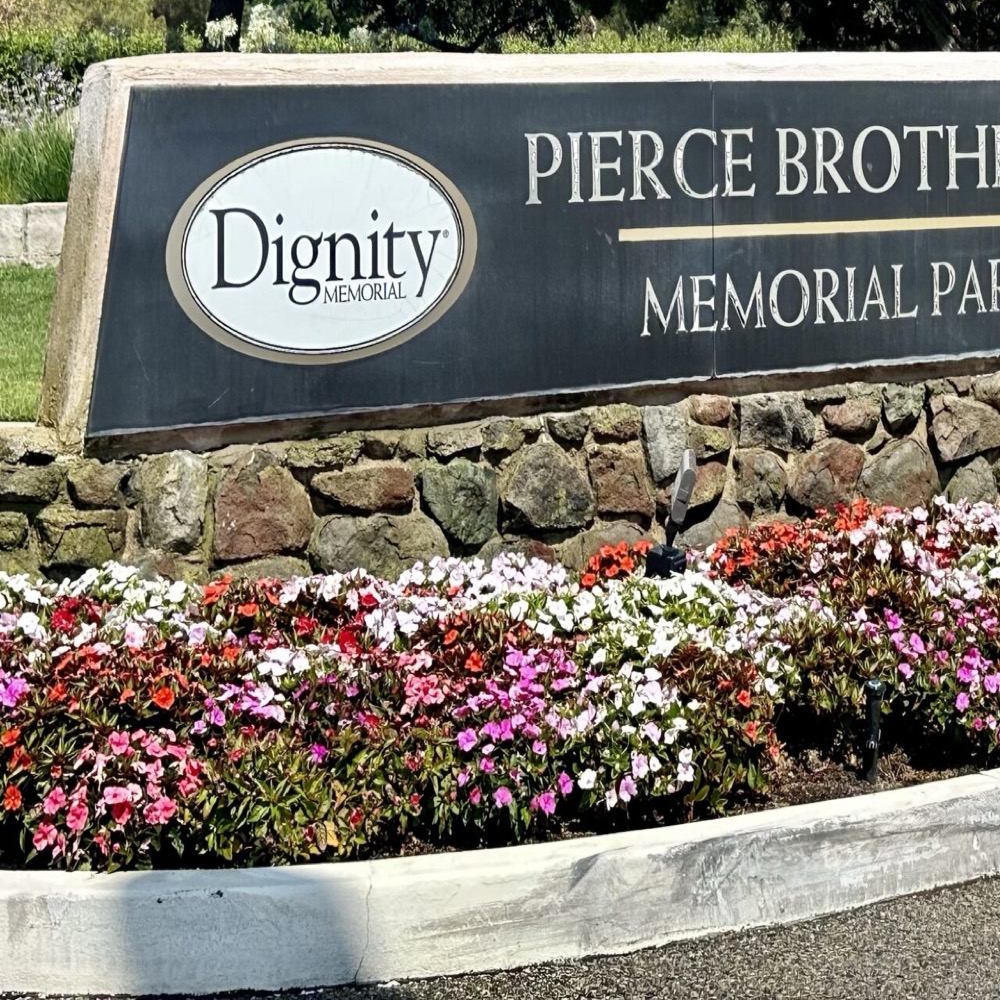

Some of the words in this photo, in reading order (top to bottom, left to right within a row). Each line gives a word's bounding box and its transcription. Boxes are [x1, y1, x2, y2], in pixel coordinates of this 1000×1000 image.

[524, 127, 756, 205] PIERCE
[322, 280, 407, 304] MEMORIAL
[640, 263, 919, 337] MEMORIAL
